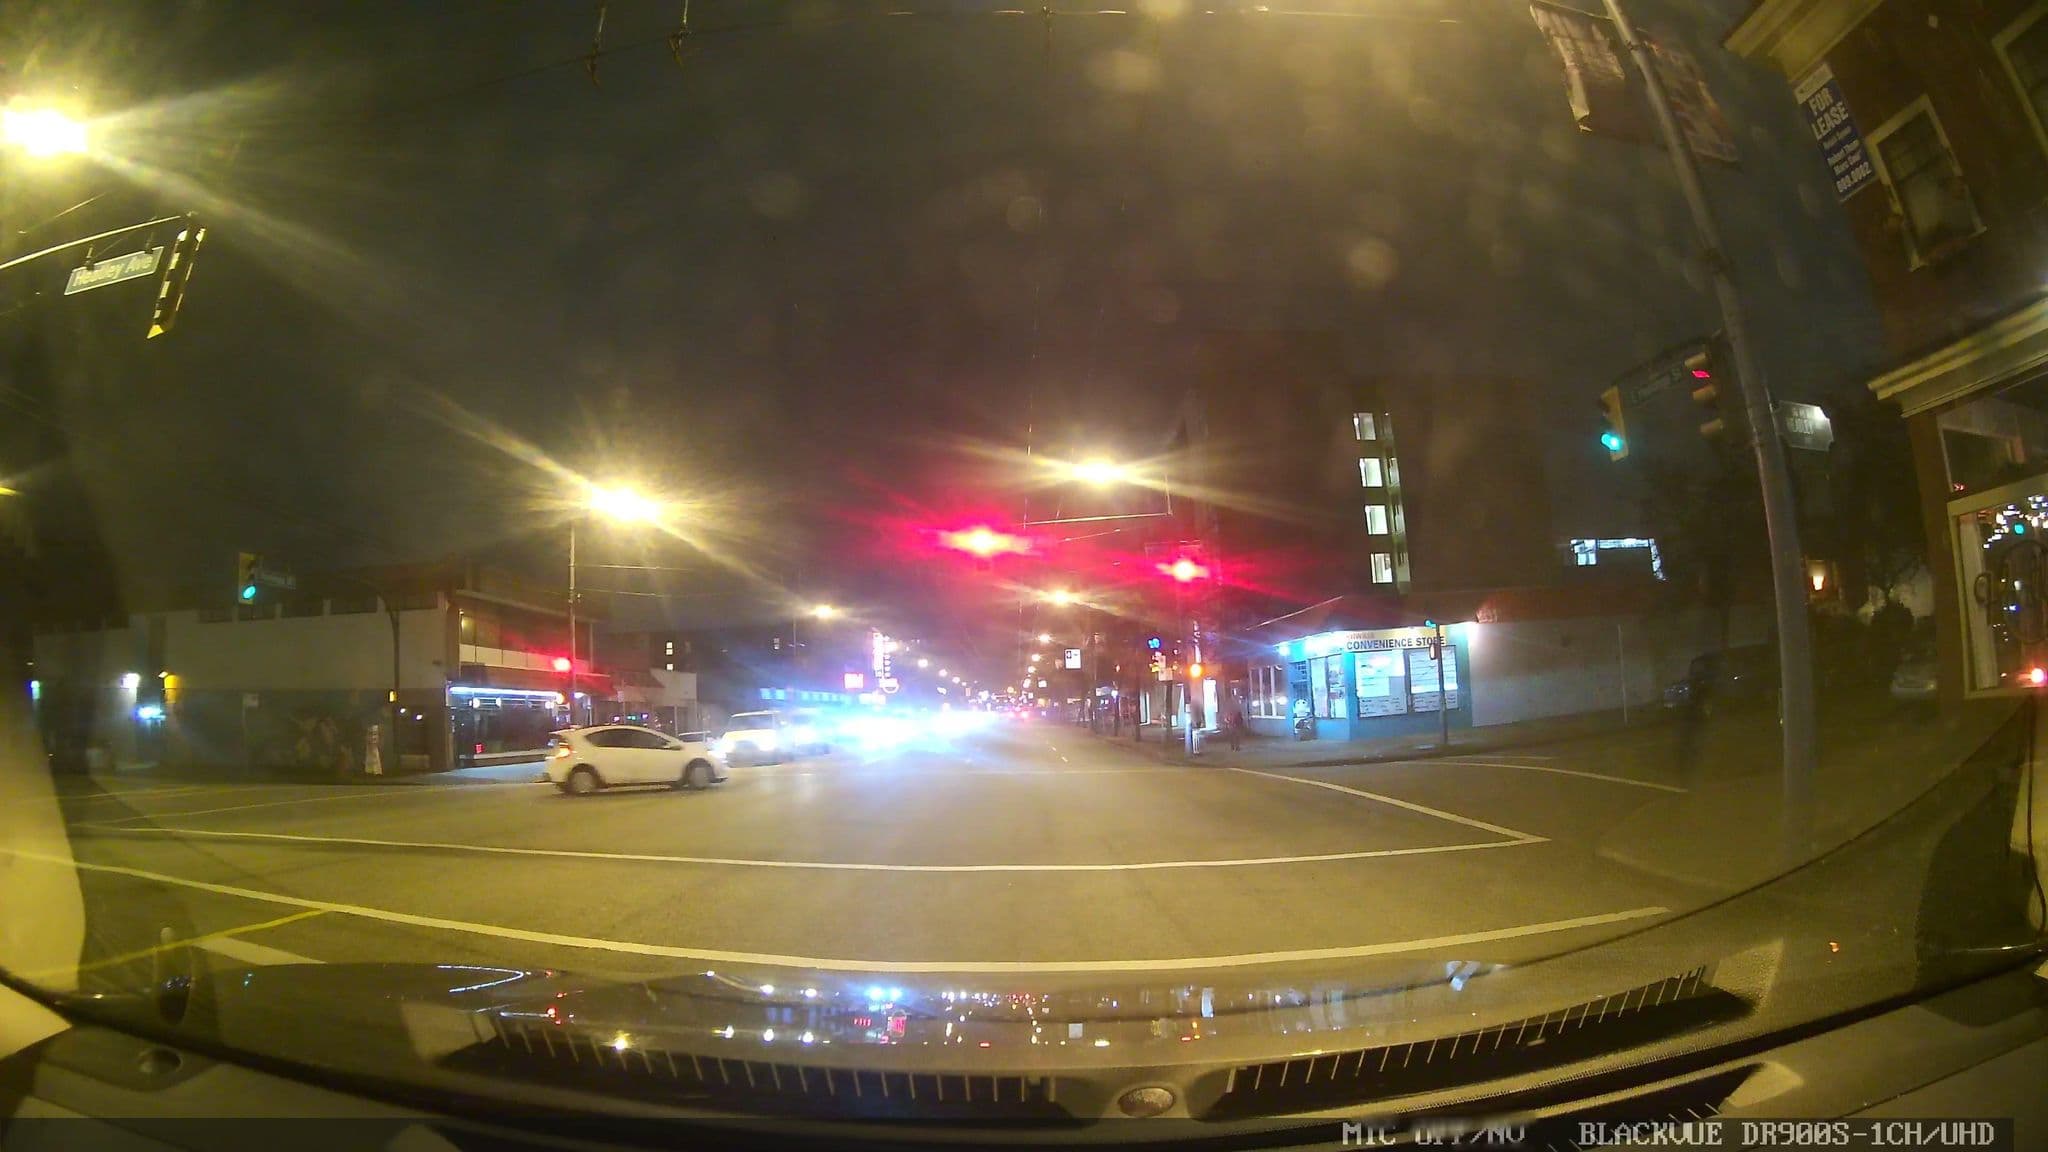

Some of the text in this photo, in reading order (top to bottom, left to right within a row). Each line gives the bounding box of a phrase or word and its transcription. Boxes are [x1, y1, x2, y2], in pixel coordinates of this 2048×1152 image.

[1808, 87, 1834, 117] FOR
[1811, 101, 1849, 140] LEASE
[124, 255, 153, 273] Ave
[1346, 635, 1445, 650] CONVENIENCE STORE
